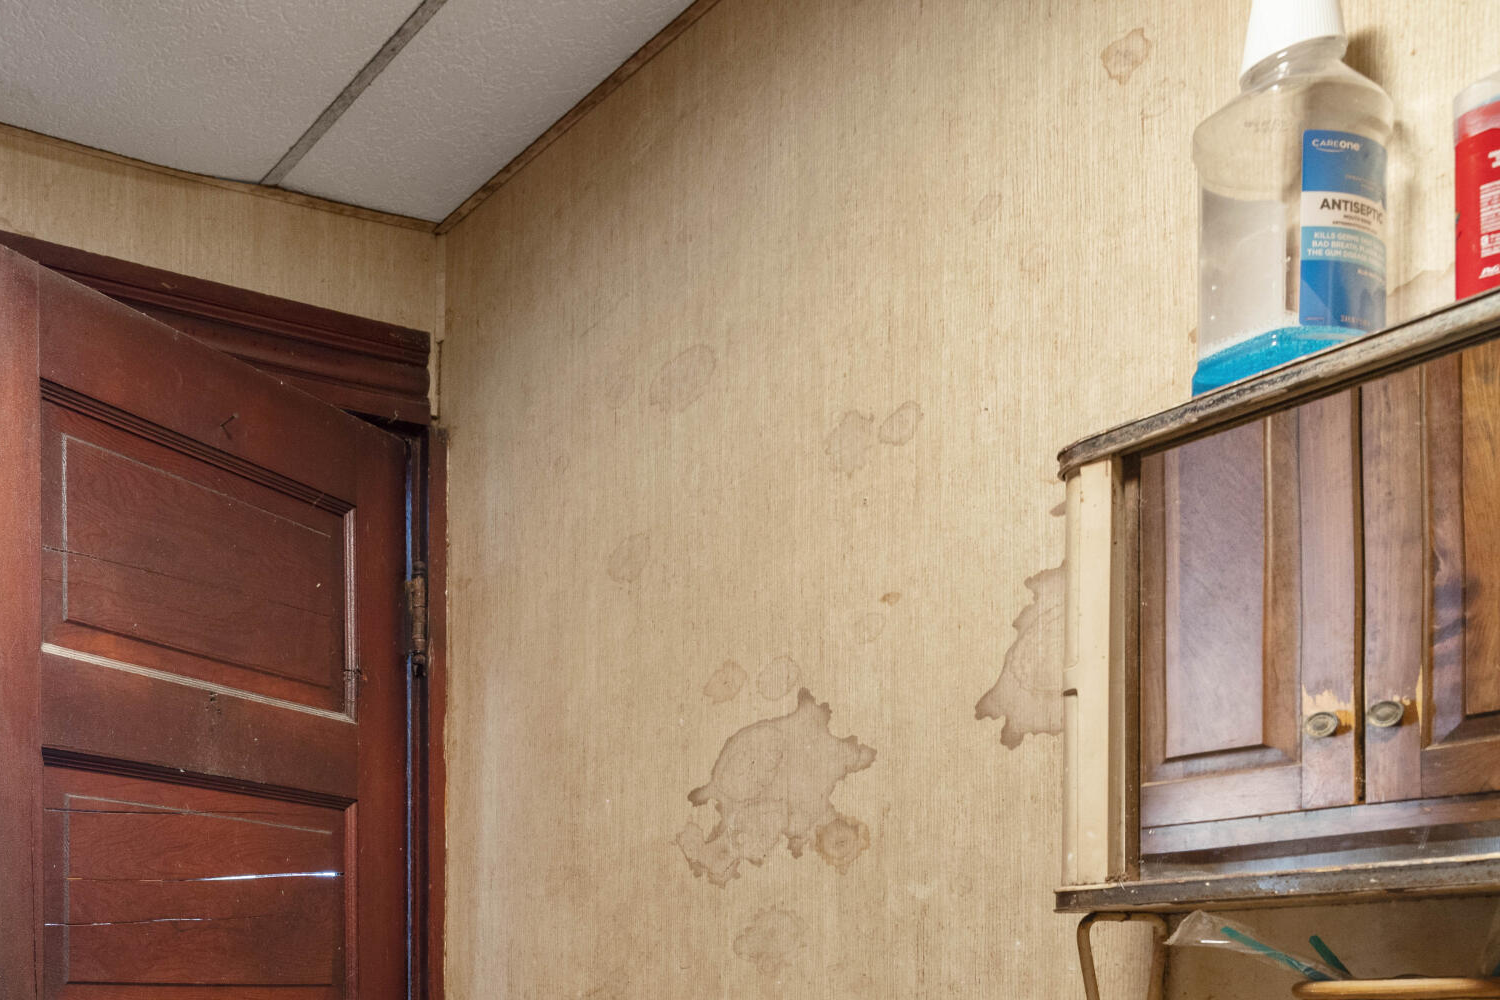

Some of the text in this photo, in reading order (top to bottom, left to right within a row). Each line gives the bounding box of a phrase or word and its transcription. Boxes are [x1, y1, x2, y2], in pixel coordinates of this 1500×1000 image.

[1320, 198, 1383, 225] ANTISEPTIC
[1314, 231, 1335, 240] KILLS
[1311, 240, 1329, 248] BAD
[1307, 248, 1323, 257] THE
